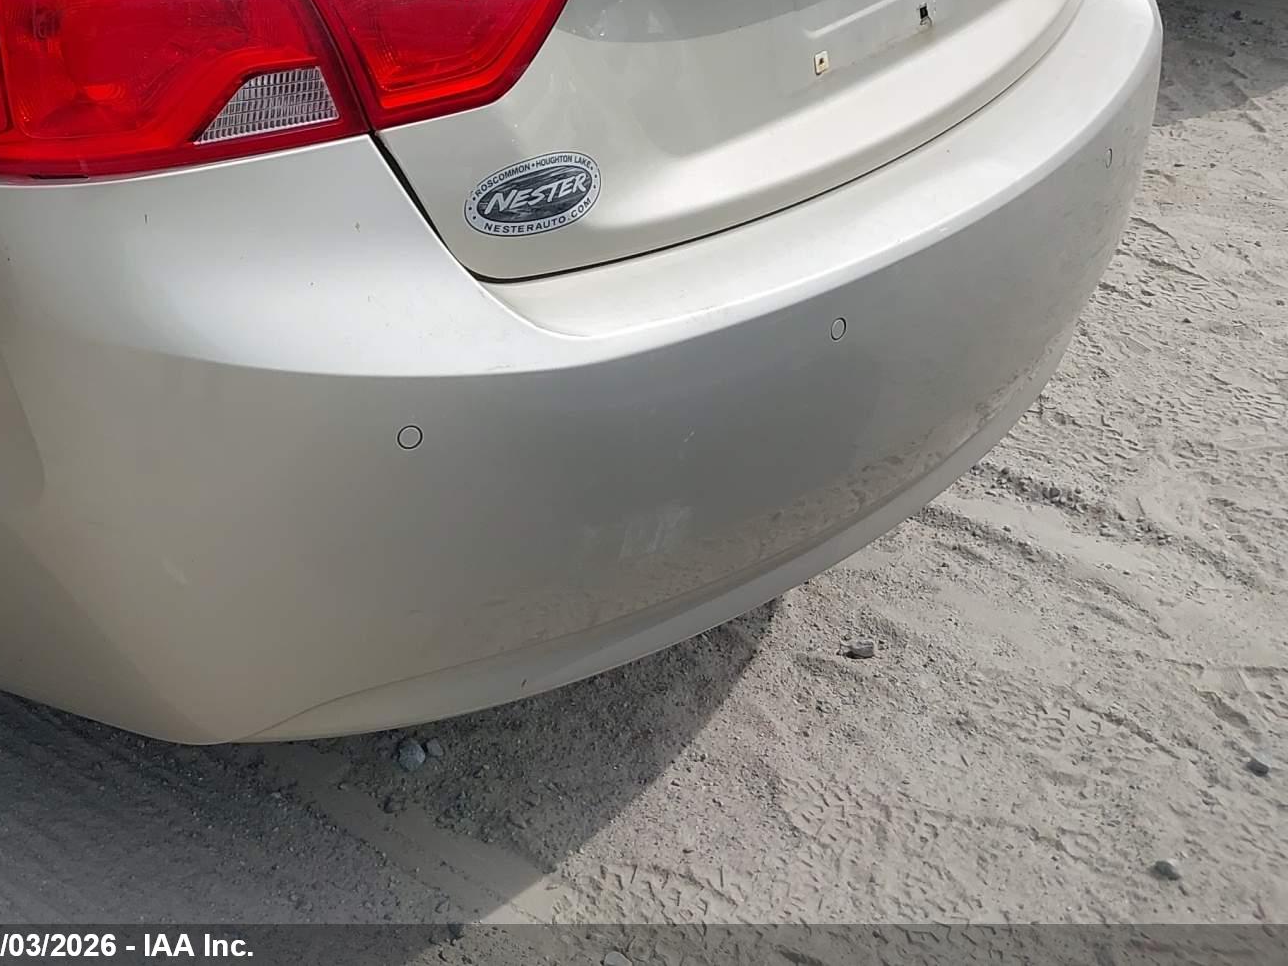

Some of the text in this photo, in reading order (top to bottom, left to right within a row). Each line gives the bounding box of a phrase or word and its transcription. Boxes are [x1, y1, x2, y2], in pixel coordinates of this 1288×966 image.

[475, 154, 592, 197] ROSCOMMON HOUGHTON LAKE
[484, 172, 588, 215] NESTER
[483, 197, 592, 234] NESTERAUTO.COM
